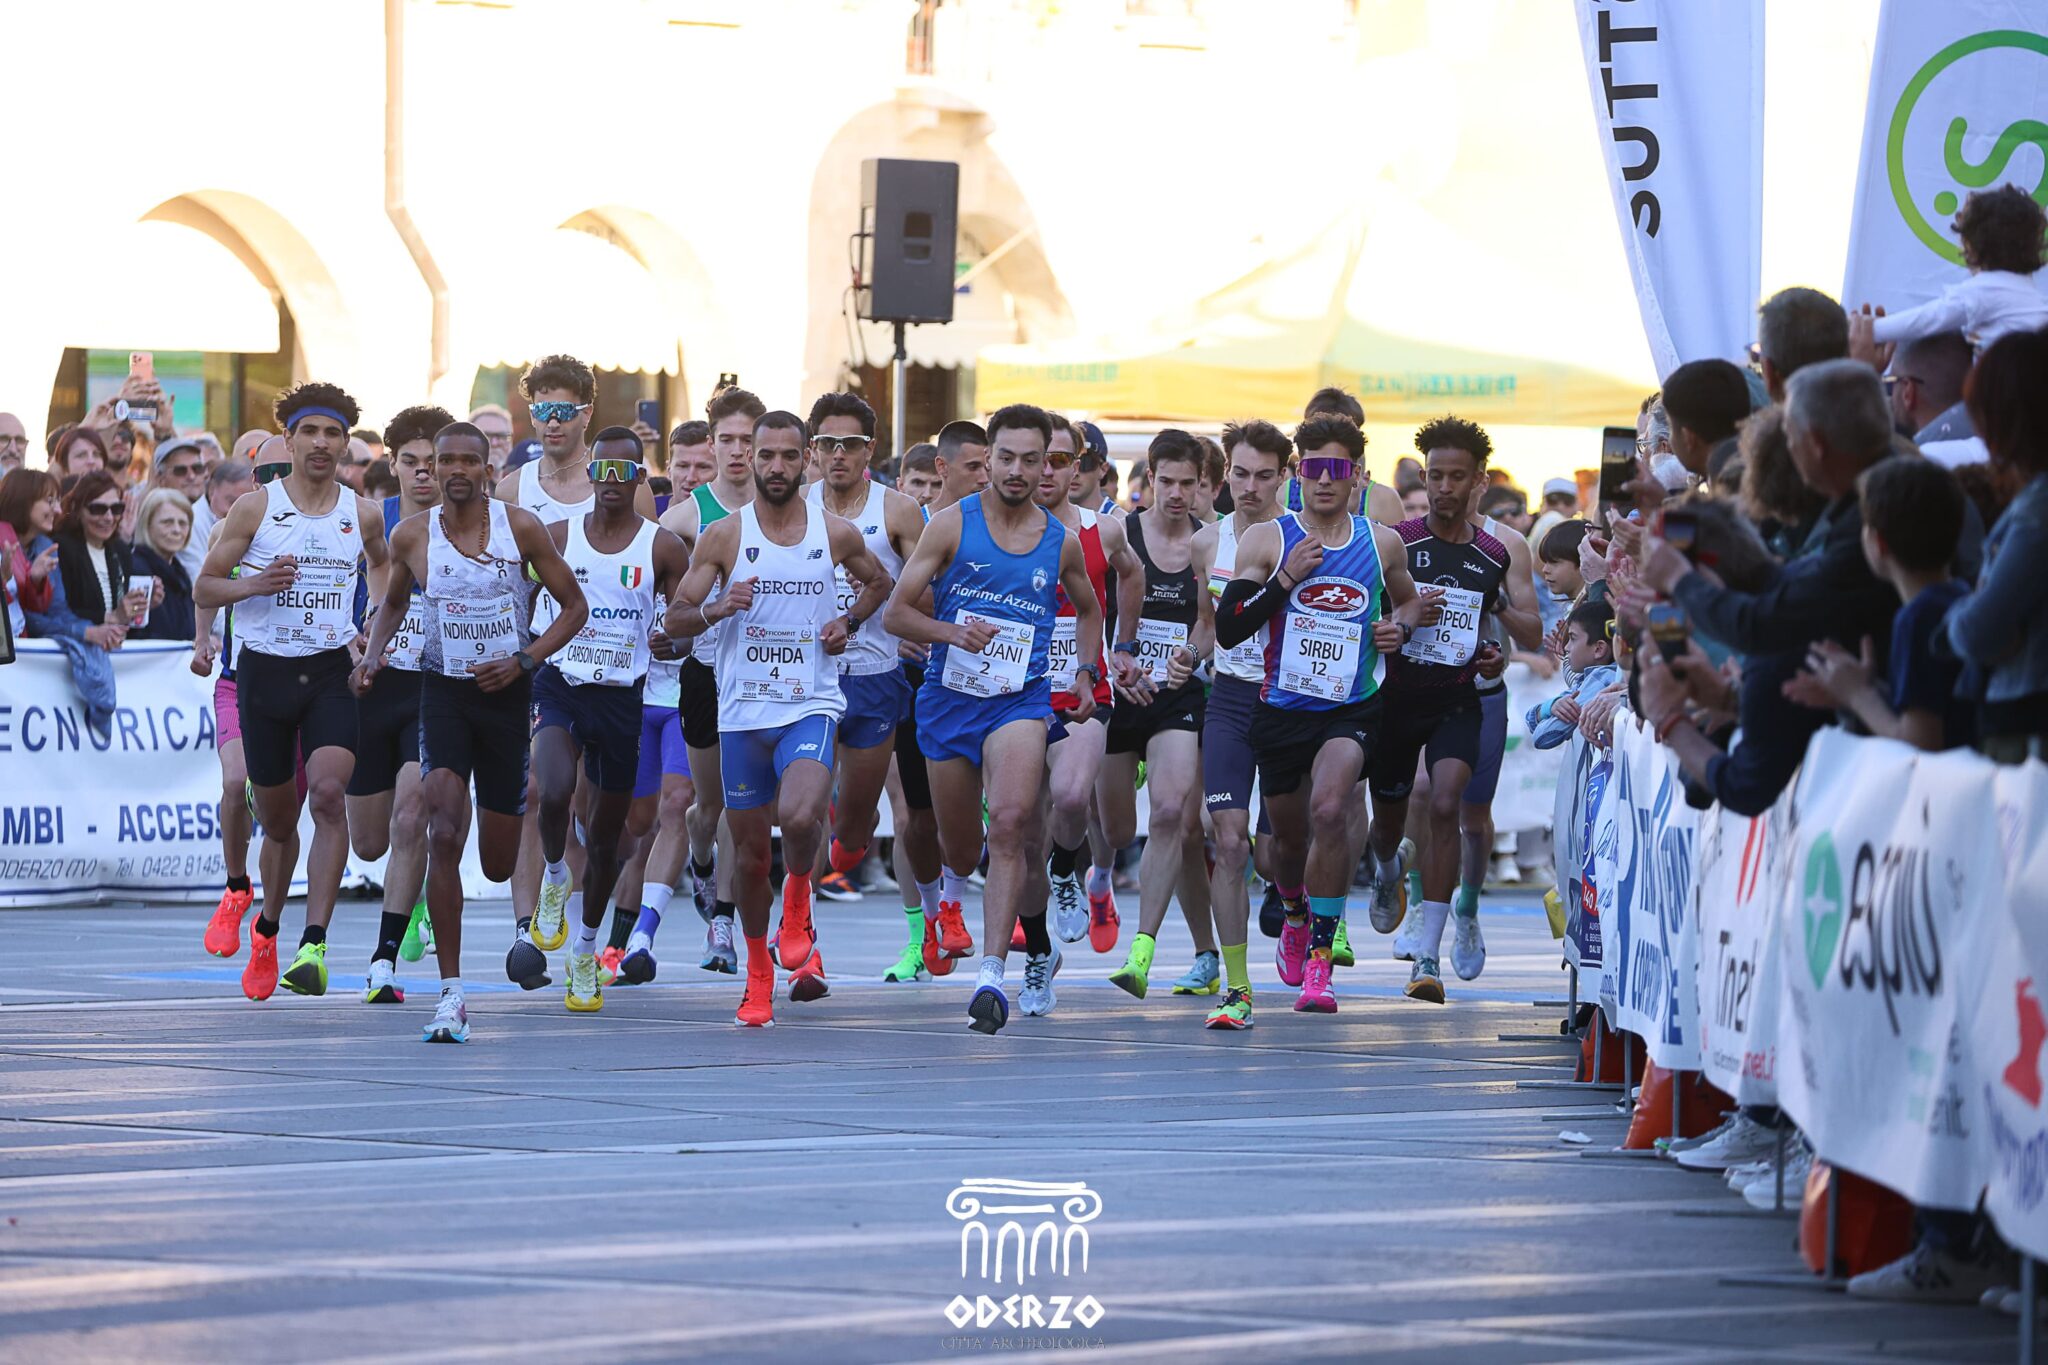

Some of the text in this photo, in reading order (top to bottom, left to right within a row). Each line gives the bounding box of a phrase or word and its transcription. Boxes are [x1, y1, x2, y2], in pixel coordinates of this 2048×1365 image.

[276, 591, 341, 609] BELGHITI
[304, 612, 314, 625] 8
[443, 617, 513, 640] NDIKUMANA
[394, 635, 409, 649] 18
[1435, 629, 1450, 643] 16
[475, 643, 485, 655] 9
[567, 645, 592, 665] CARSON
[746, 646, 804, 664] OUHDA
[1299, 638, 1343, 661] SIRBU
[980, 661, 990, 674] 2
[1050, 659, 1067, 671] 27
[1311, 661, 1327, 676] 12
[593, 668, 603, 681] 6
[769, 666, 780, 680] 4
[1206, 792, 1232, 804] HOKA
[65, 858, 97, 878] (TV)
[142, 856, 181, 877] 0422
